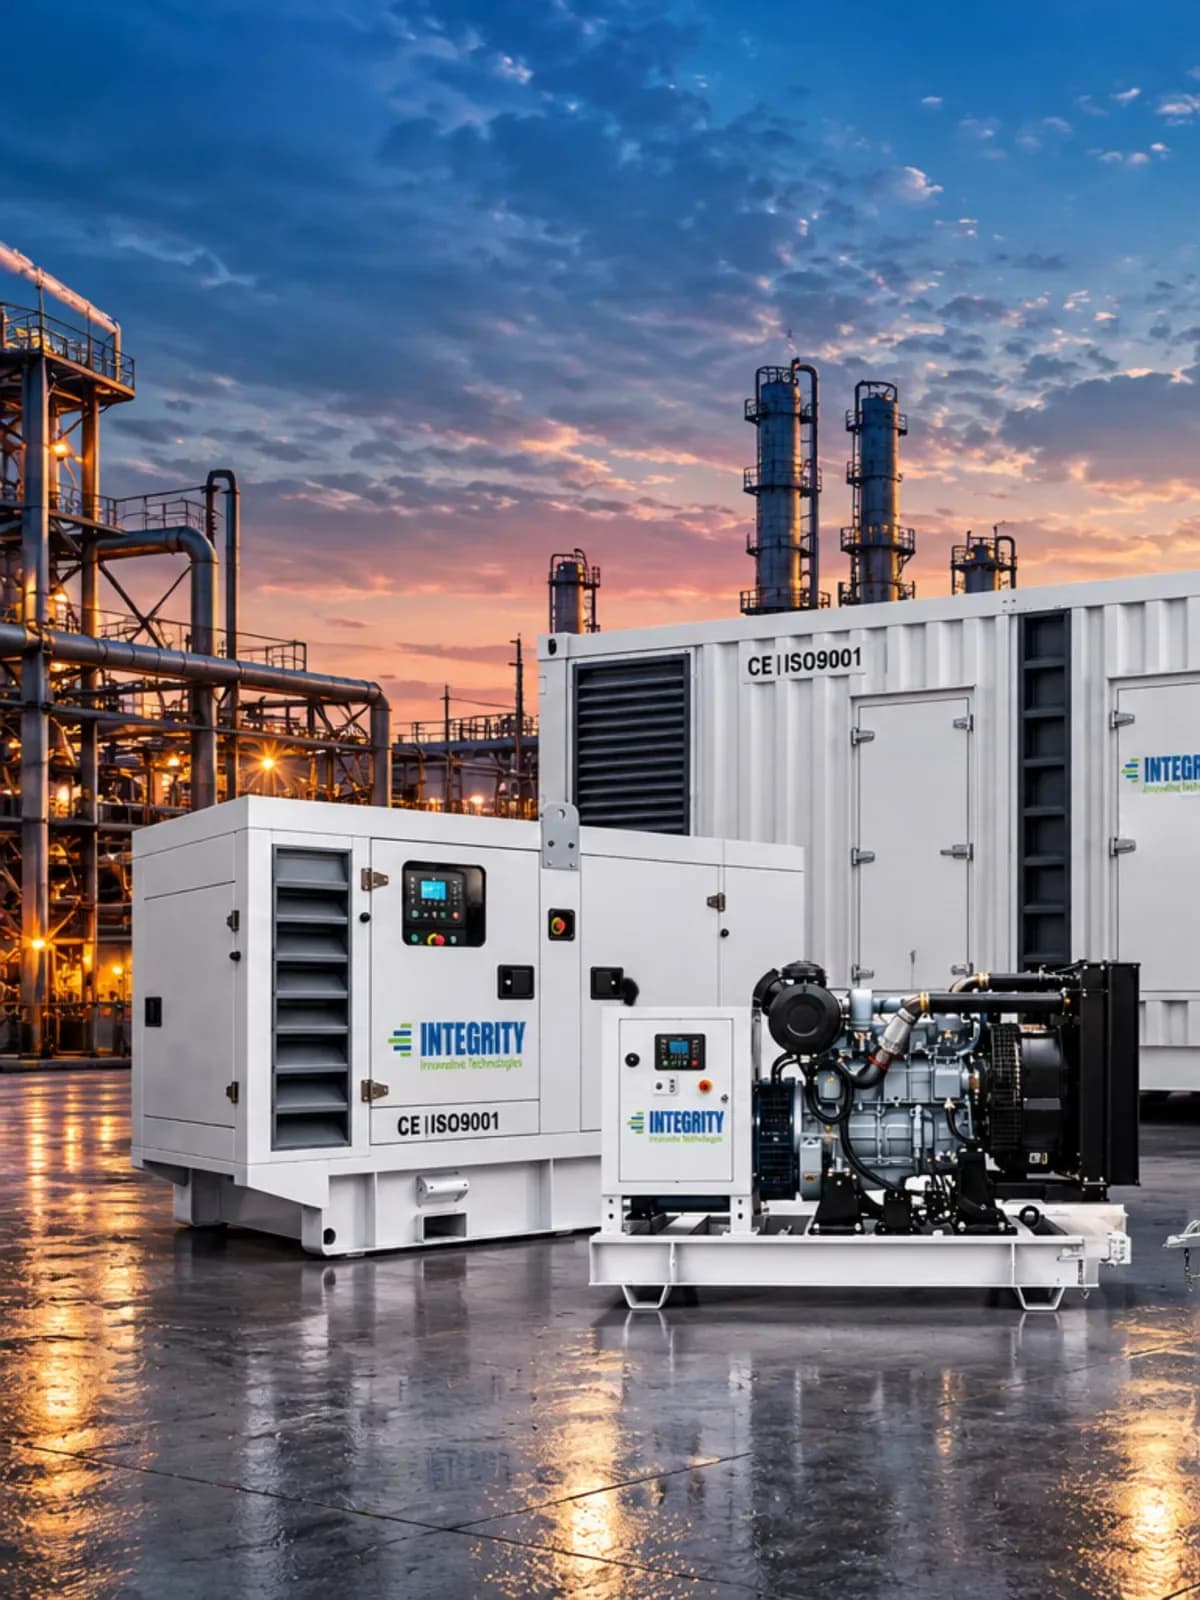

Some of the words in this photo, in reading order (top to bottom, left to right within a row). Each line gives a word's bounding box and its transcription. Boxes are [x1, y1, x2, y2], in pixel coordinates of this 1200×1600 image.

[748, 656, 773, 676] CE
[785, 646, 861, 673] ISO9001
[420, 1021, 527, 1056] INTEGRITY
[397, 1115, 421, 1136] CE
[431, 1111, 499, 1134] ISO9001
[649, 1110, 725, 1133] INTEGRITY
